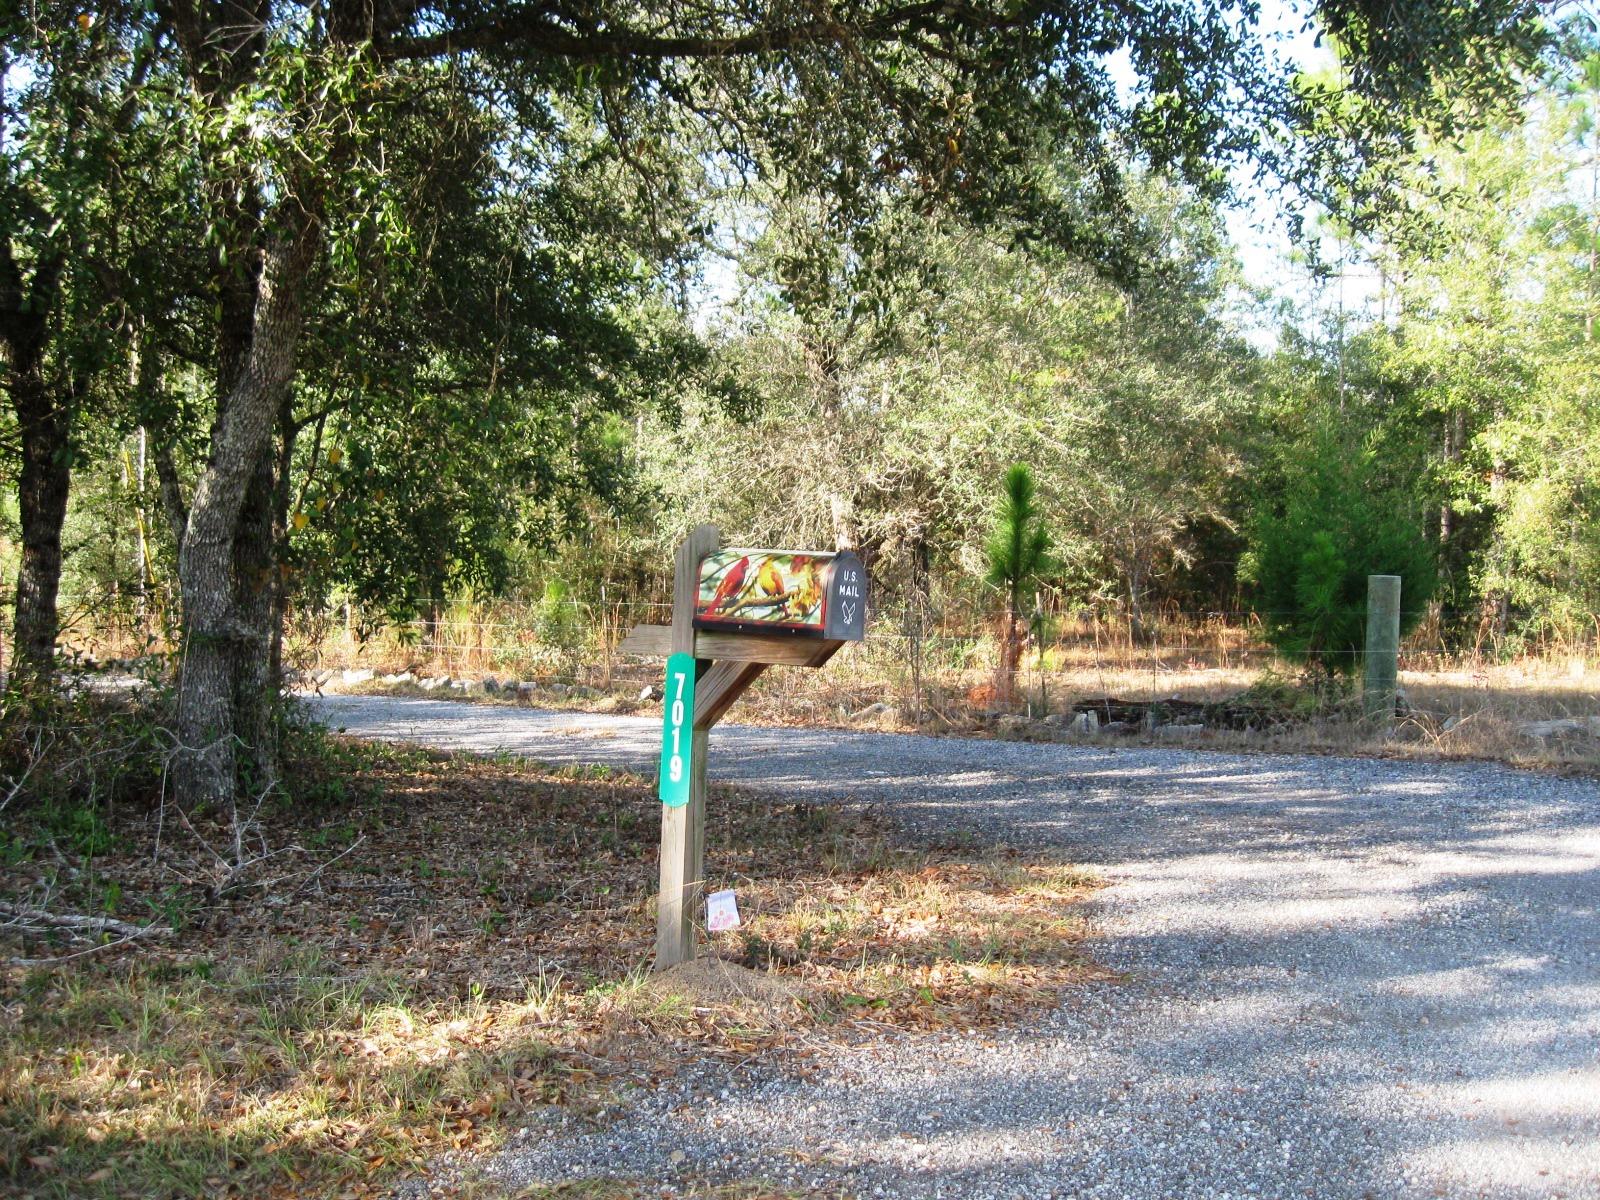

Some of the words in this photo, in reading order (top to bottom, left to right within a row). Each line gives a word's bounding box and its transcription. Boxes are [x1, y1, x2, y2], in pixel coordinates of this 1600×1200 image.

[843, 569, 858, 582] U.S.
[839, 584, 860, 598] MAIL
[669, 672, 686, 783] 7019
